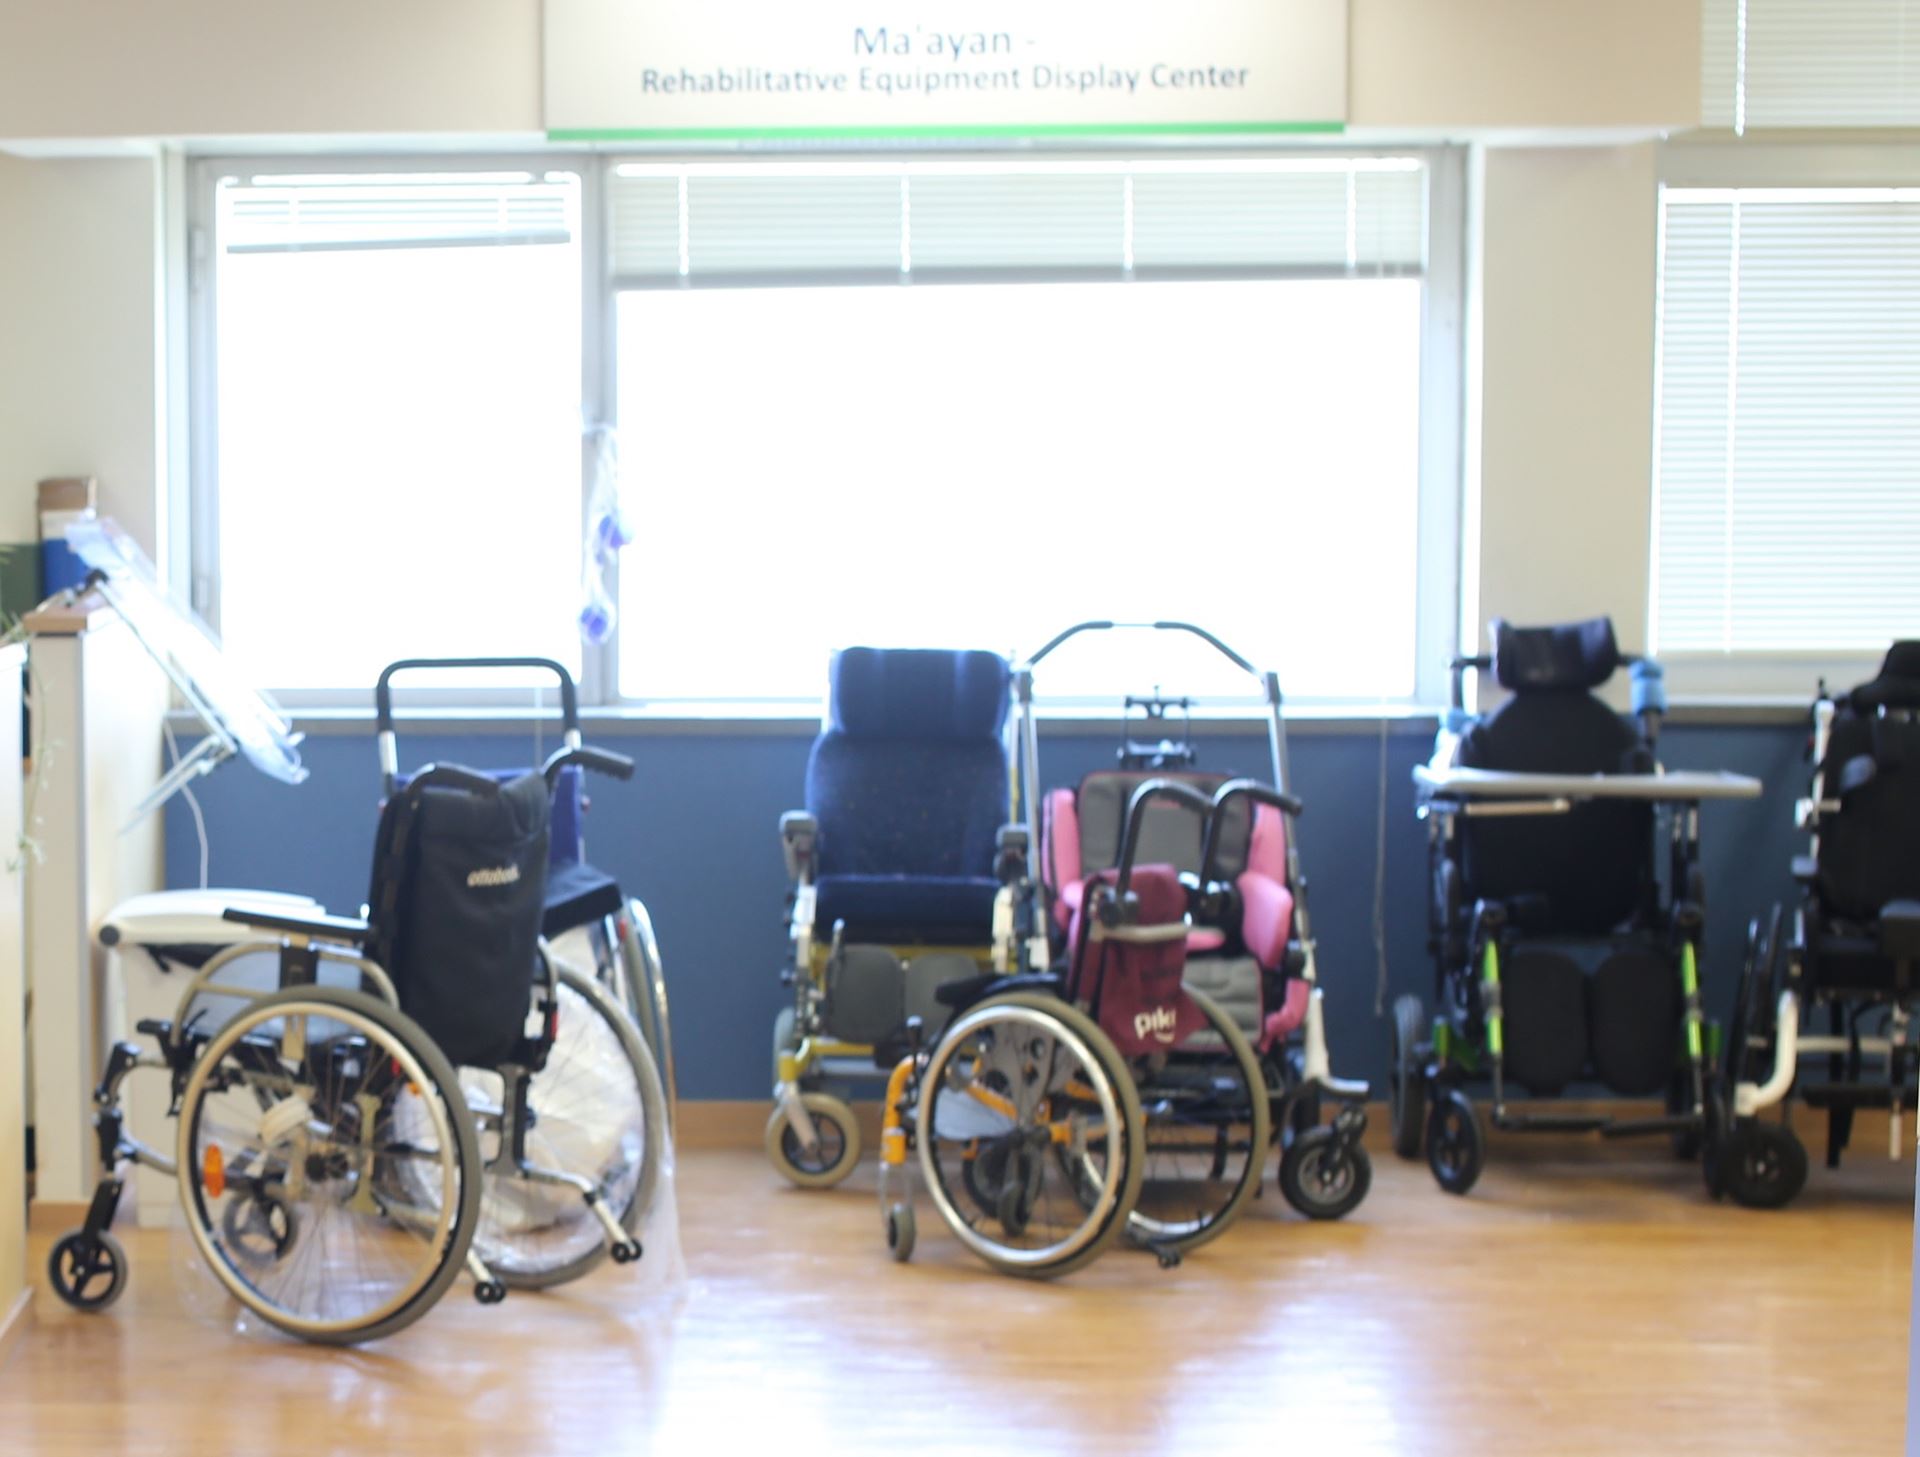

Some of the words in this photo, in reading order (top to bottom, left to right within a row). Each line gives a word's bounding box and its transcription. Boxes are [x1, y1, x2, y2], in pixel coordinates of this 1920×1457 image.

[853, 26, 1012, 60] Ma'ayan
[641, 68, 847, 93] Rehabilitative
[858, 67, 1021, 94] Equipment
[1032, 64, 1140, 92] Display
[1149, 64, 1250, 88] Center
